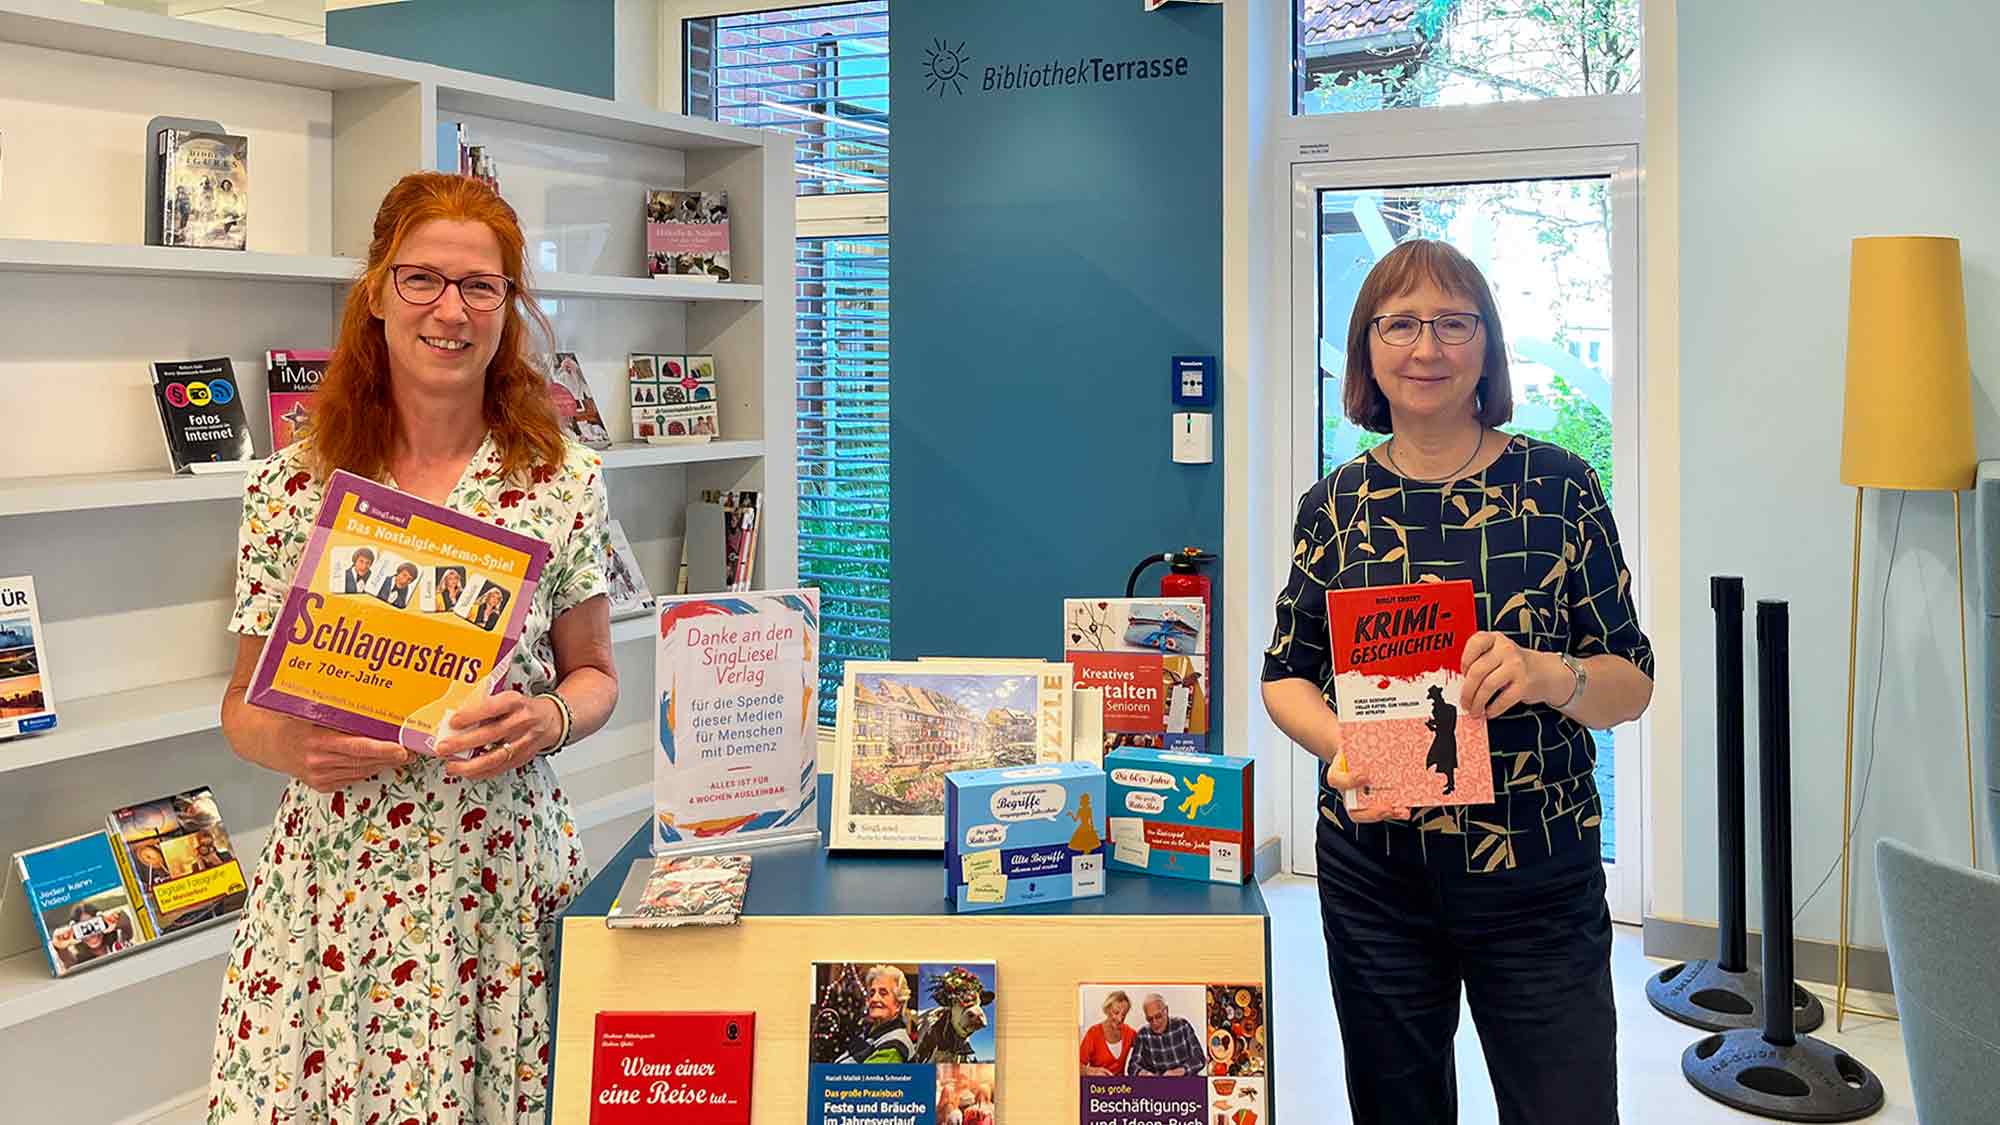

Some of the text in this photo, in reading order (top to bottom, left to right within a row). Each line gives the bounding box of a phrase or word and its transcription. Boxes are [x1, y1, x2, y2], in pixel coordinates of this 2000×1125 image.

[982, 56, 1188, 91] BibliothekTerrasse
[281, 366, 328, 383] iMov
[189, 414, 220, 426] Fotos
[185, 428, 233, 441] Internet
[347, 518, 515, 573] Das Nostalgie-Memo-Spiel
[1, 588, 28, 607] ÜR
[1354, 599, 1452, 644] KRIMI-
[288, 591, 482, 685] Schlagerstars
[687, 624, 793, 648] Danke an den
[702, 643, 779, 670] SingLiesel
[1350, 631, 1455, 665] GESCHICHTEN
[289, 656, 393, 689] der 70er-Jahre
[715, 664, 765, 688] Verlag
[1082, 667, 1135, 680] Kreatives
[691, 692, 785, 713] für die Spende
[1106, 700, 1151, 712] Senioren
[692, 708, 783, 728] dieser Medien
[696, 724, 783, 743] für Menschen
[701, 741, 777, 759] mit Demenz
[997, 794, 1040, 811] Begriffe
[620, 1056, 716, 1077] Wenn einer
[599, 1083, 641, 1105] eine
[646, 1080, 708, 1105] Reise
[824, 1088, 904, 1100] Das große Praxisbuch
[1089, 1084, 1132, 1097] Das große
[823, 1100, 927, 1113] Feste und Bräuche
[1090, 1097, 1203, 1117] Beschäftigungs-
[823, 1115, 916, 1125] im Jahresverlauf
